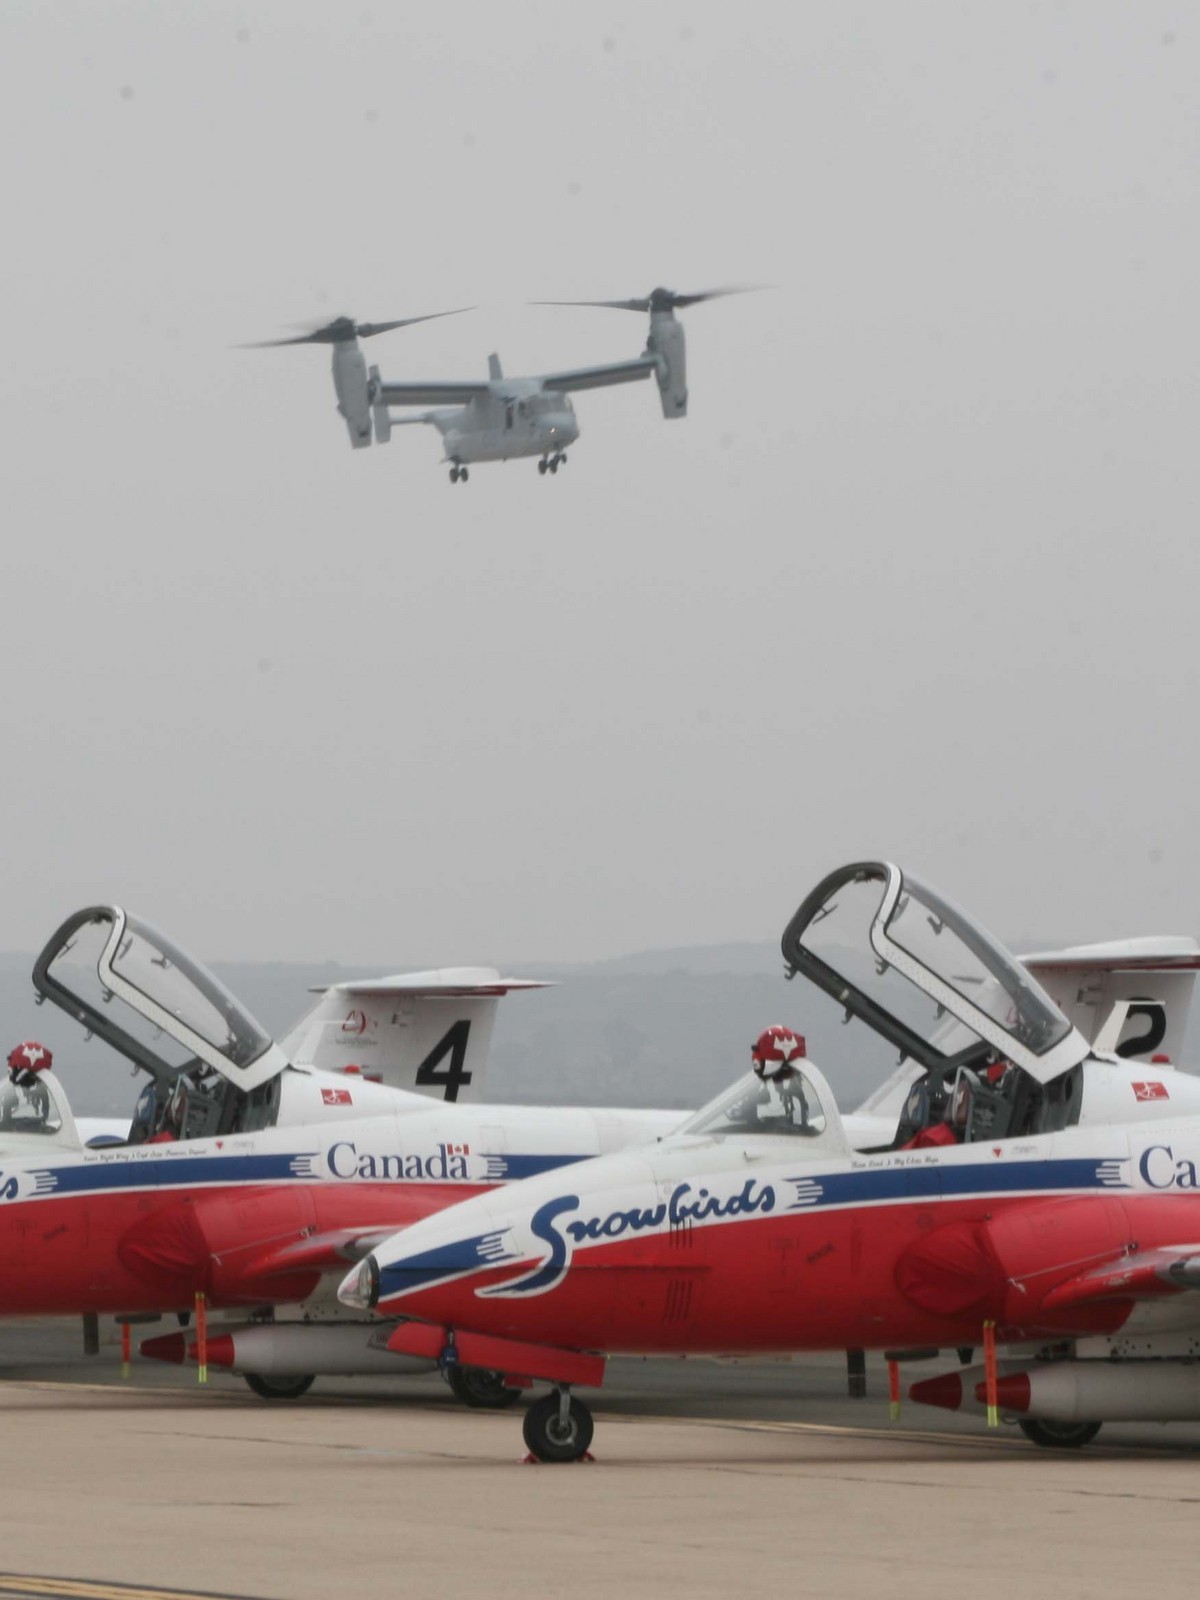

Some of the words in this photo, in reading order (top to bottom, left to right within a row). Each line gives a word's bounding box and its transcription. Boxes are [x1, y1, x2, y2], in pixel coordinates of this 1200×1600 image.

[416, 1019, 472, 1103] 4
[327, 1142, 470, 1180] Canada
[477, 1179, 776, 1296] Snowbirds
